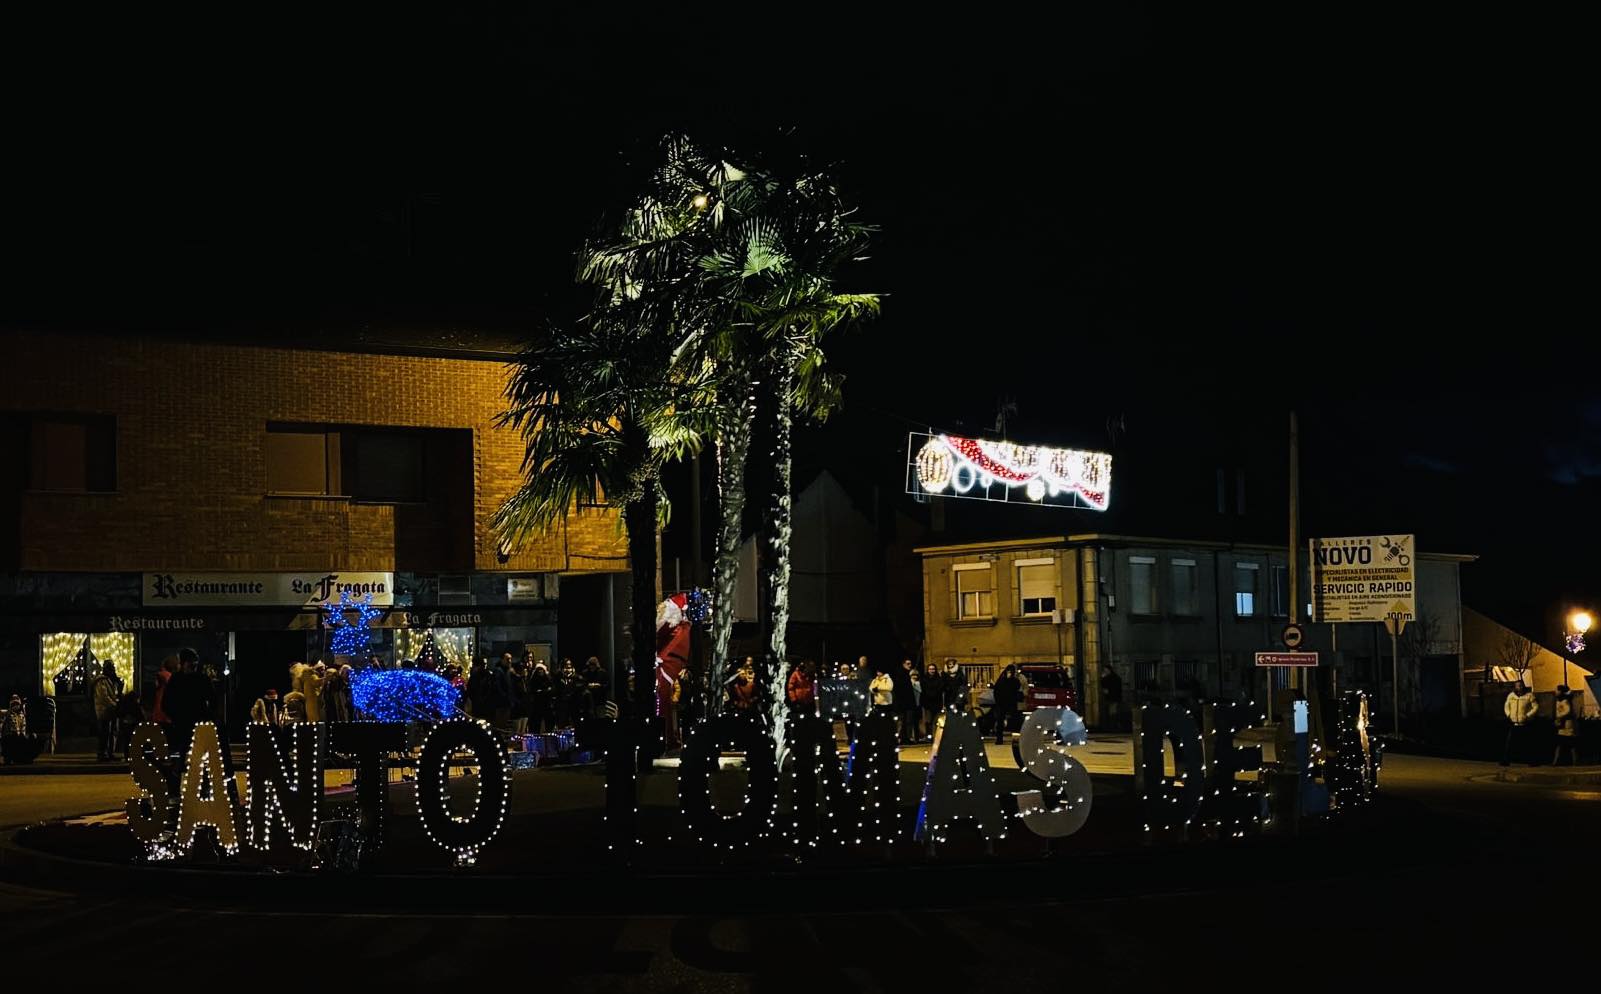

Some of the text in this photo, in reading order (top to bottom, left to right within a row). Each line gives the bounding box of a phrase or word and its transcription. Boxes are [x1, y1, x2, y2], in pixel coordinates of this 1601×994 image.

[1313, 546, 1371, 566] NOVO
[151, 574, 386, 602] Restaurante La Fragata
[107, 615, 205, 630] Restaurante
[403, 611, 481, 626] La Fragata
[125, 717, 512, 854] SANTO
[584, 706, 1094, 849] TOMAS
